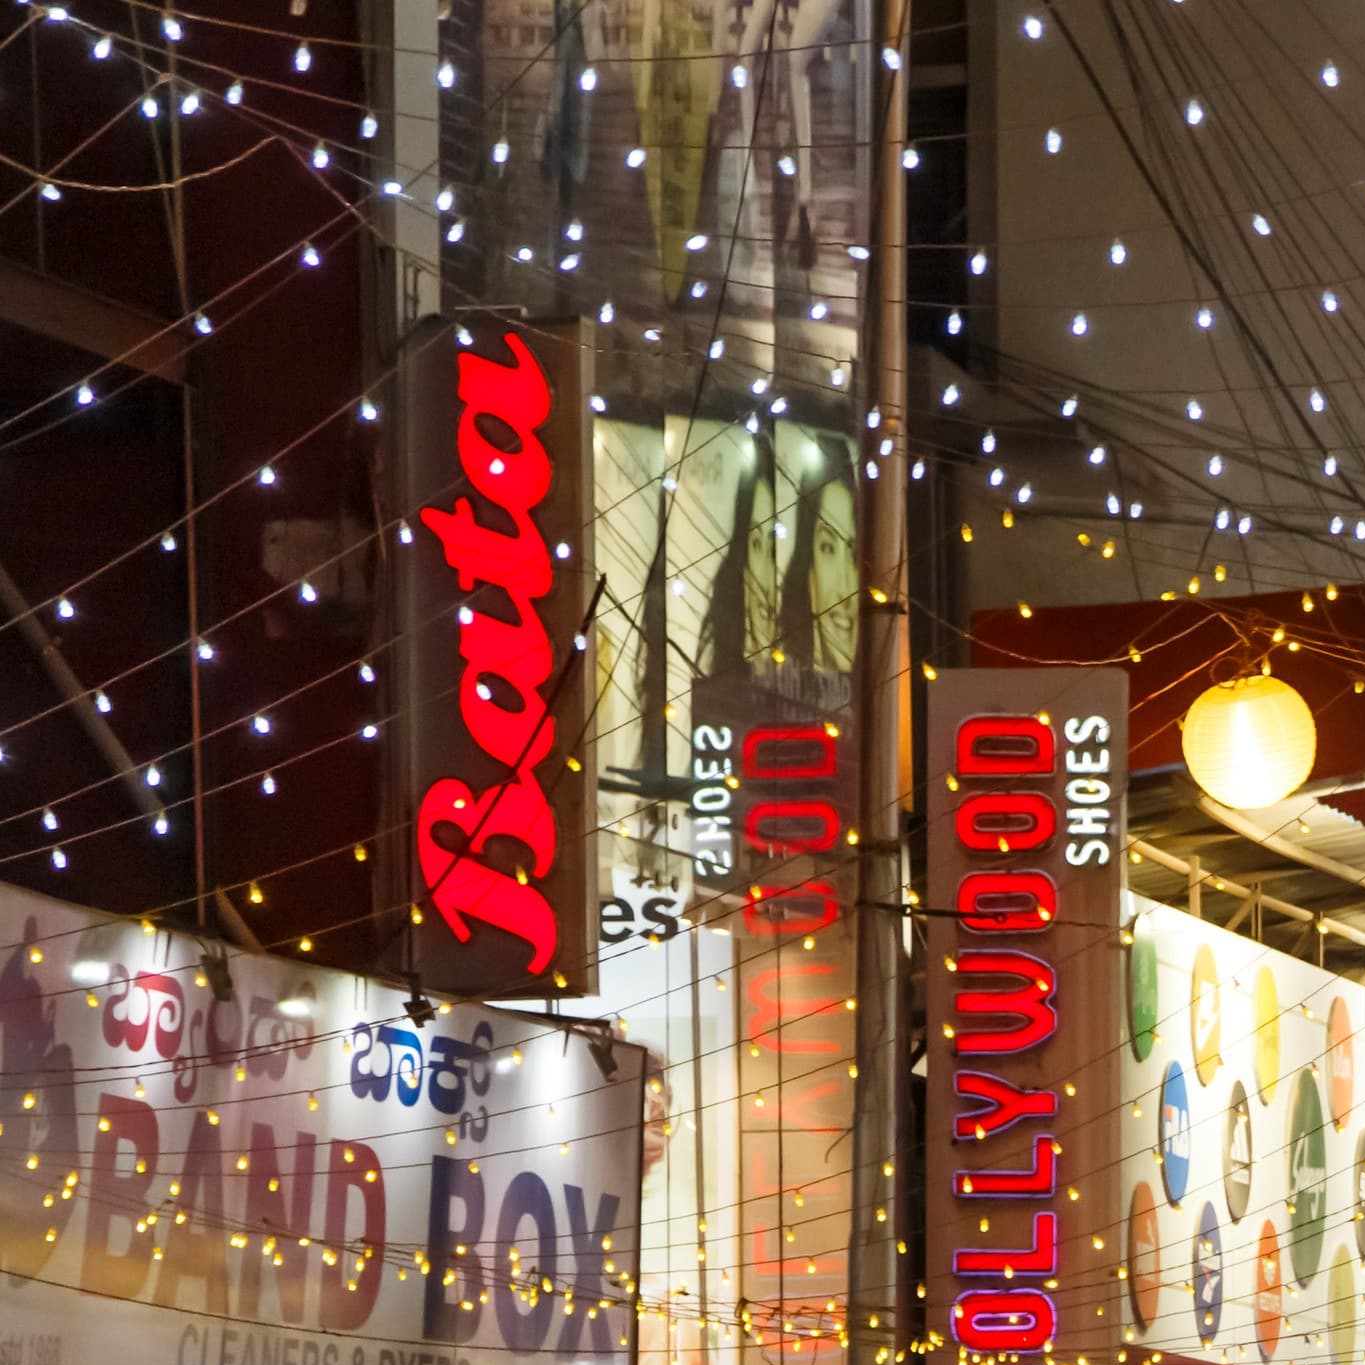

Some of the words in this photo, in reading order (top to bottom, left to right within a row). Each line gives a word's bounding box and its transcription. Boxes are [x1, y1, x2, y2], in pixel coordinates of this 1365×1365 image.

[420, 332, 556, 975] Bata
[1065, 714, 1111, 867] SHOES
[81, 1093, 387, 1331] BAND
[422, 1154, 621, 1358] BOX
